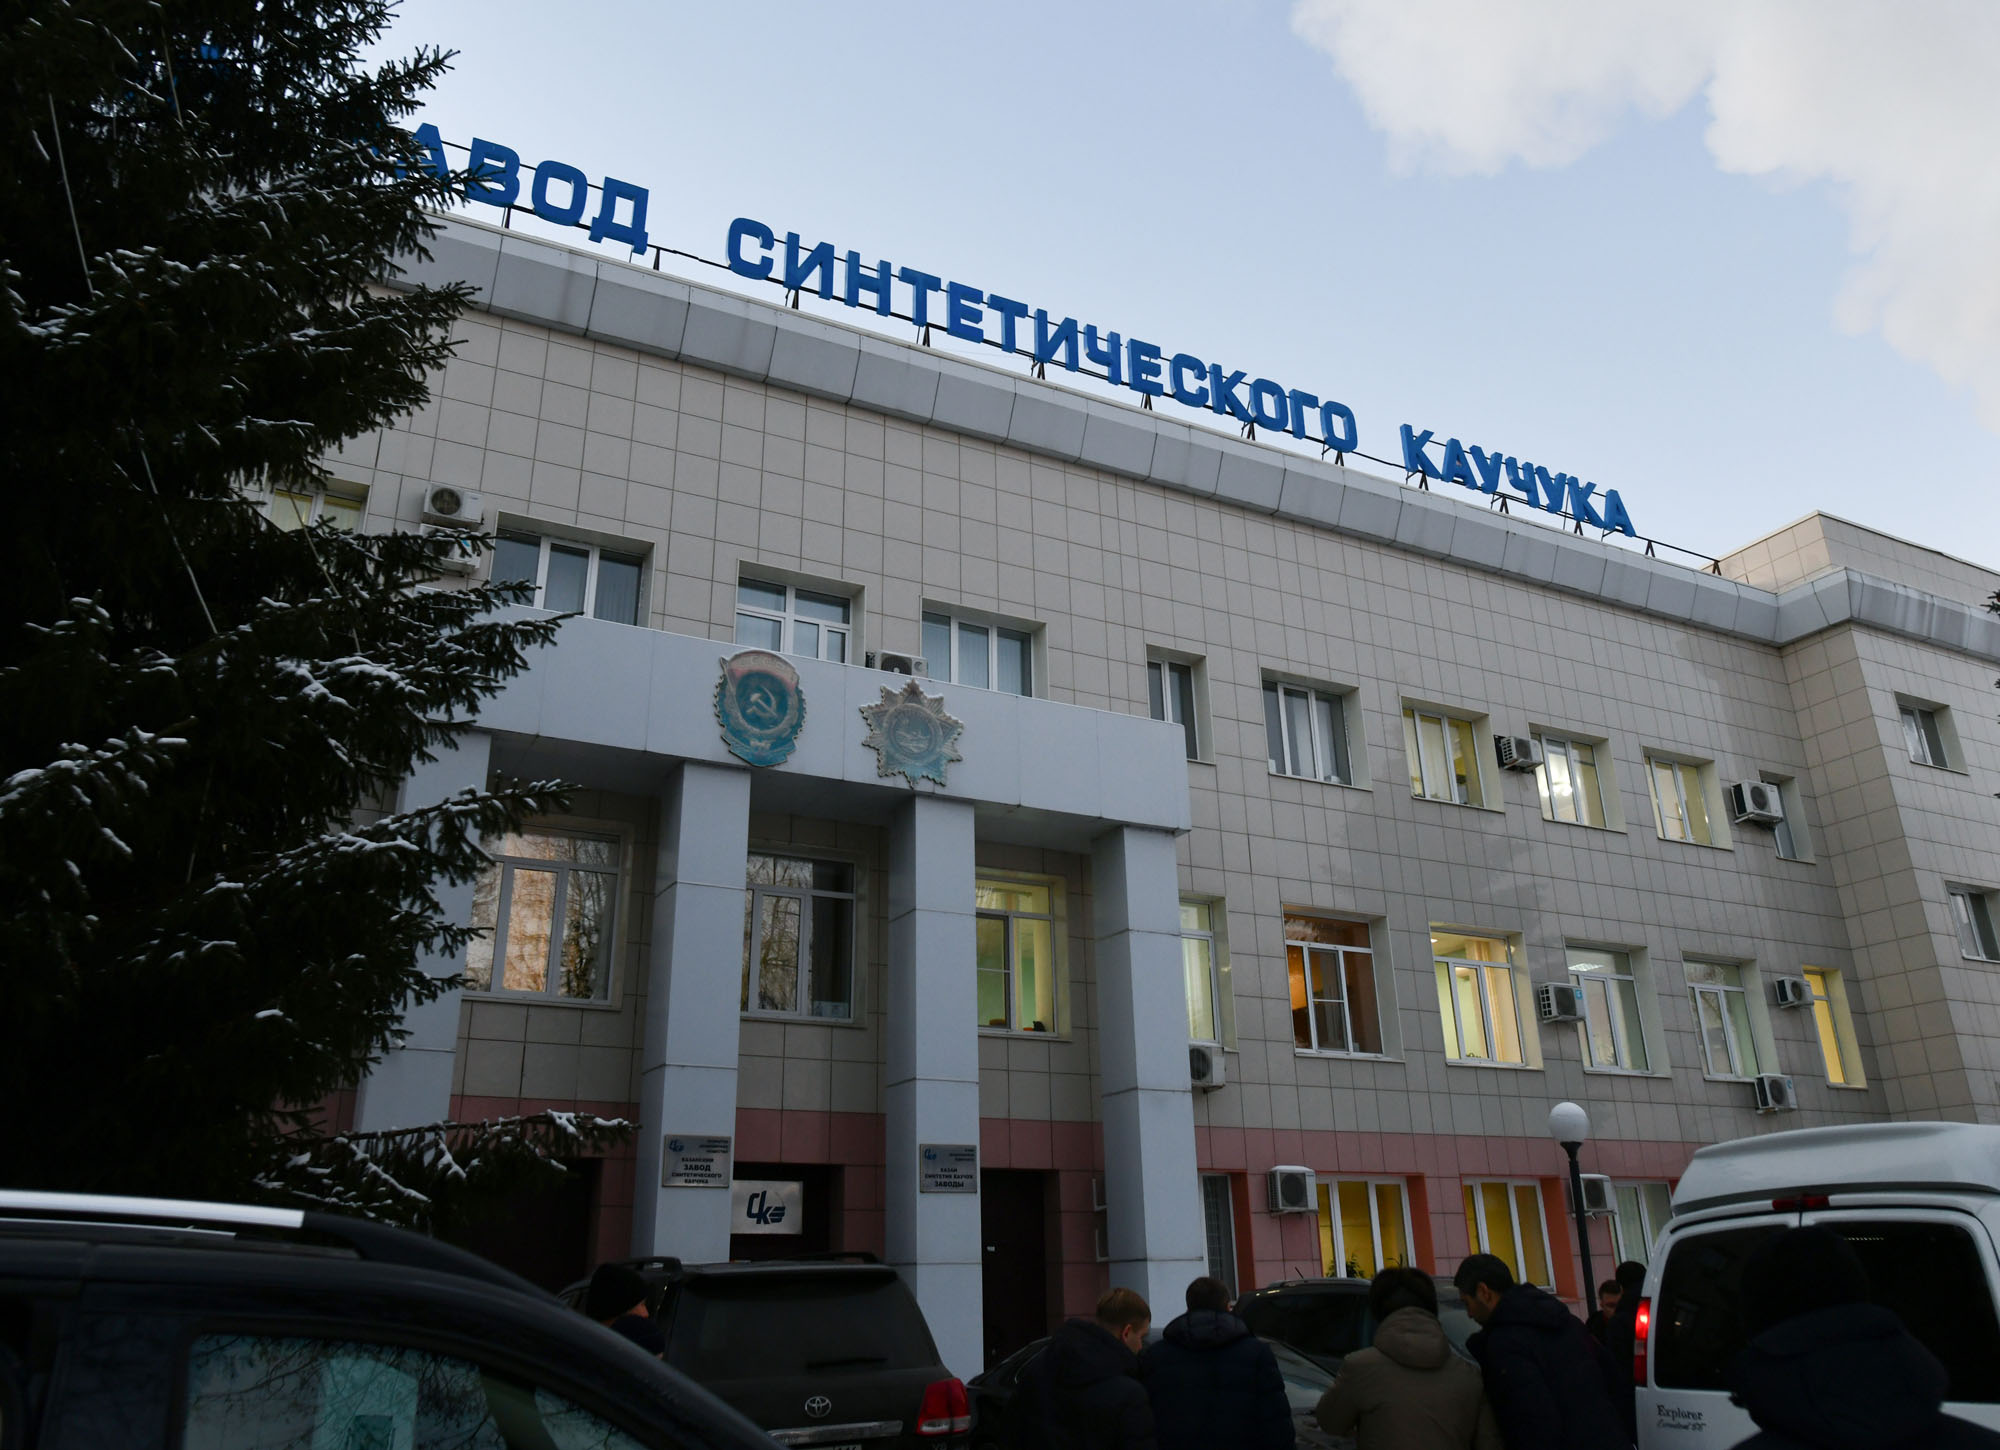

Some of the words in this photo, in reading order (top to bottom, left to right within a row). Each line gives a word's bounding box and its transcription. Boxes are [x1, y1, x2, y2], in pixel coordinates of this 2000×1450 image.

[354, 121, 649, 255] АВОД
[728, 217, 1358, 453] СИНТЕТИЧЕСКОГО
[1400, 423, 1636, 538] КАУЧУКА
[683, 1164, 711, 1172] ЗАВОД
[1656, 1404, 1704, 1421] Explorer
